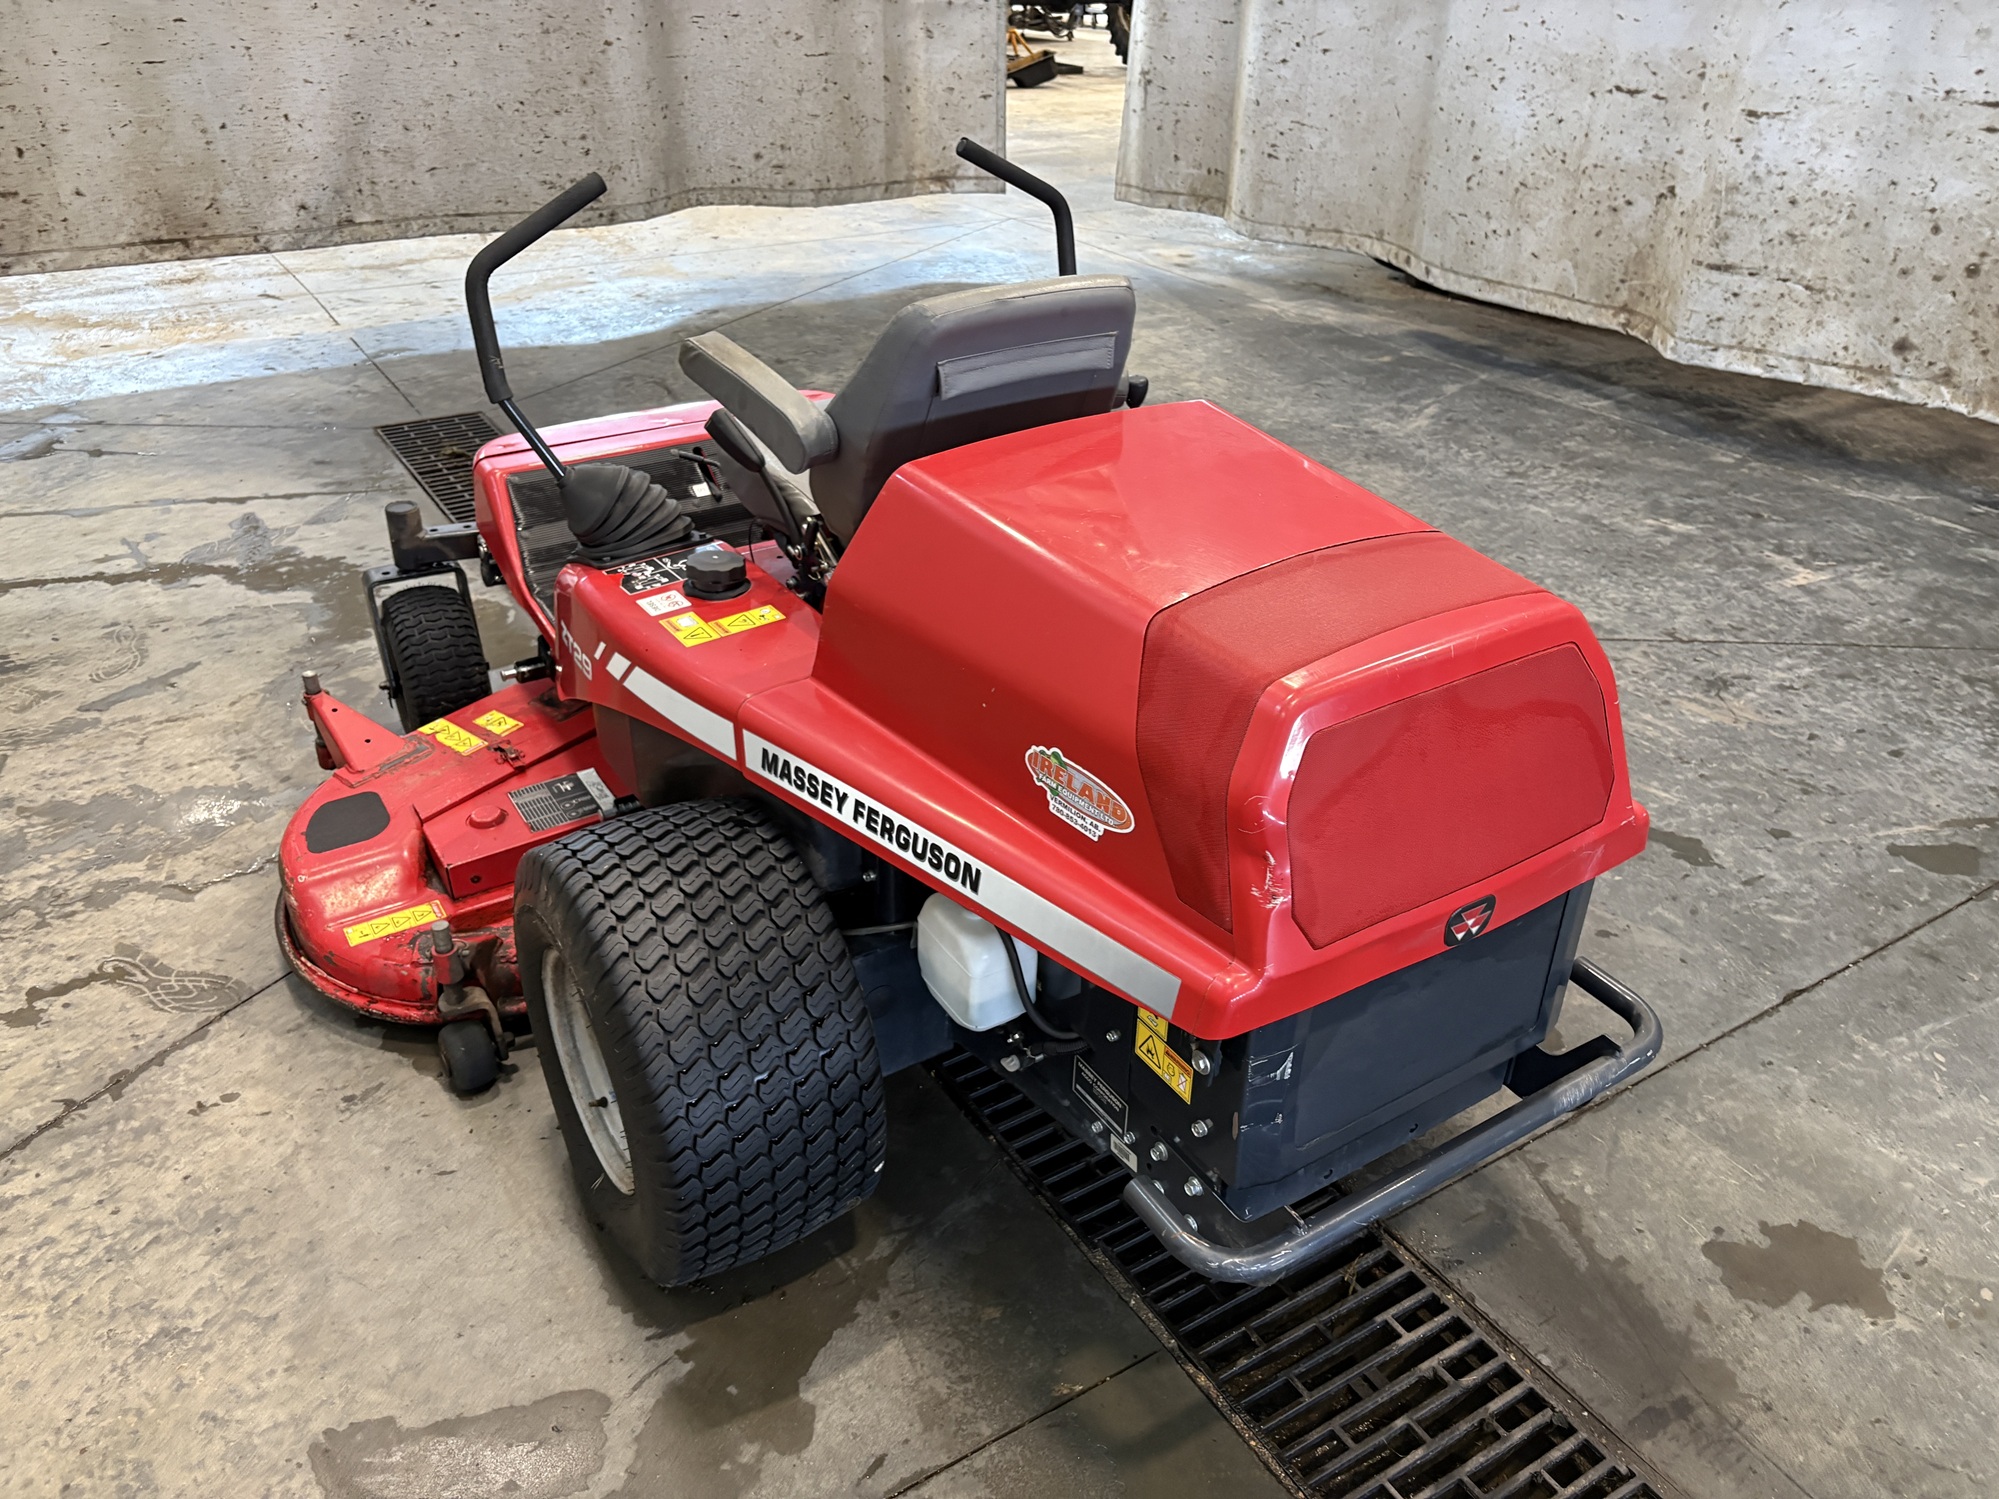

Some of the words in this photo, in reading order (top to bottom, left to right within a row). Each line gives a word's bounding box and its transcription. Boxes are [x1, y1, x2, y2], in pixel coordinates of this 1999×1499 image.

[1031, 749, 1128, 823] IRELAND
[1039, 772, 1058, 790] FARM
[761, 747, 849, 815] MASSEY
[852, 798, 982, 896] FERGUSON
